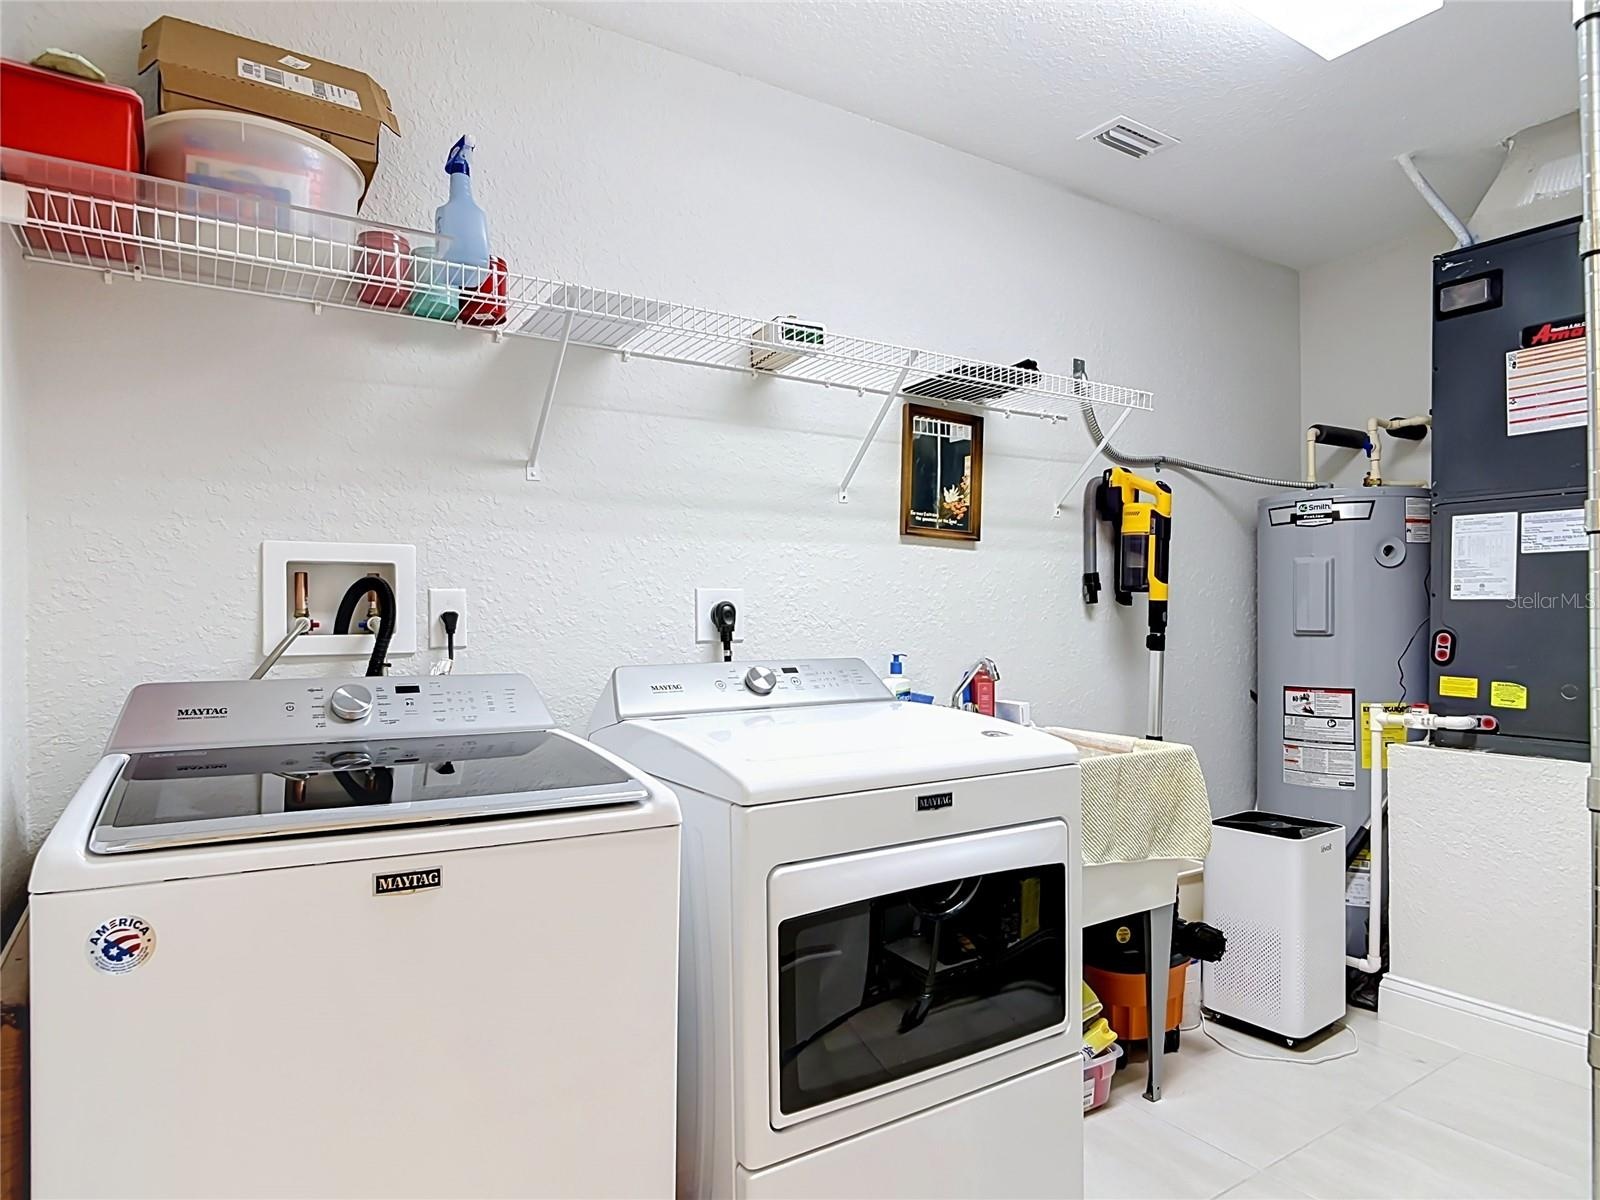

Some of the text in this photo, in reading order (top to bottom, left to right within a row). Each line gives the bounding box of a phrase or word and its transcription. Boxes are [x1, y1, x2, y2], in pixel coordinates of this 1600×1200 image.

[651, 683, 683, 691] MAYTAG
[177, 707, 228, 716] MAYTAG
[919, 795, 952, 807] MAYTAG
[378, 872, 440, 891] MAYTAG
[90, 918, 150, 946] AMERICA
